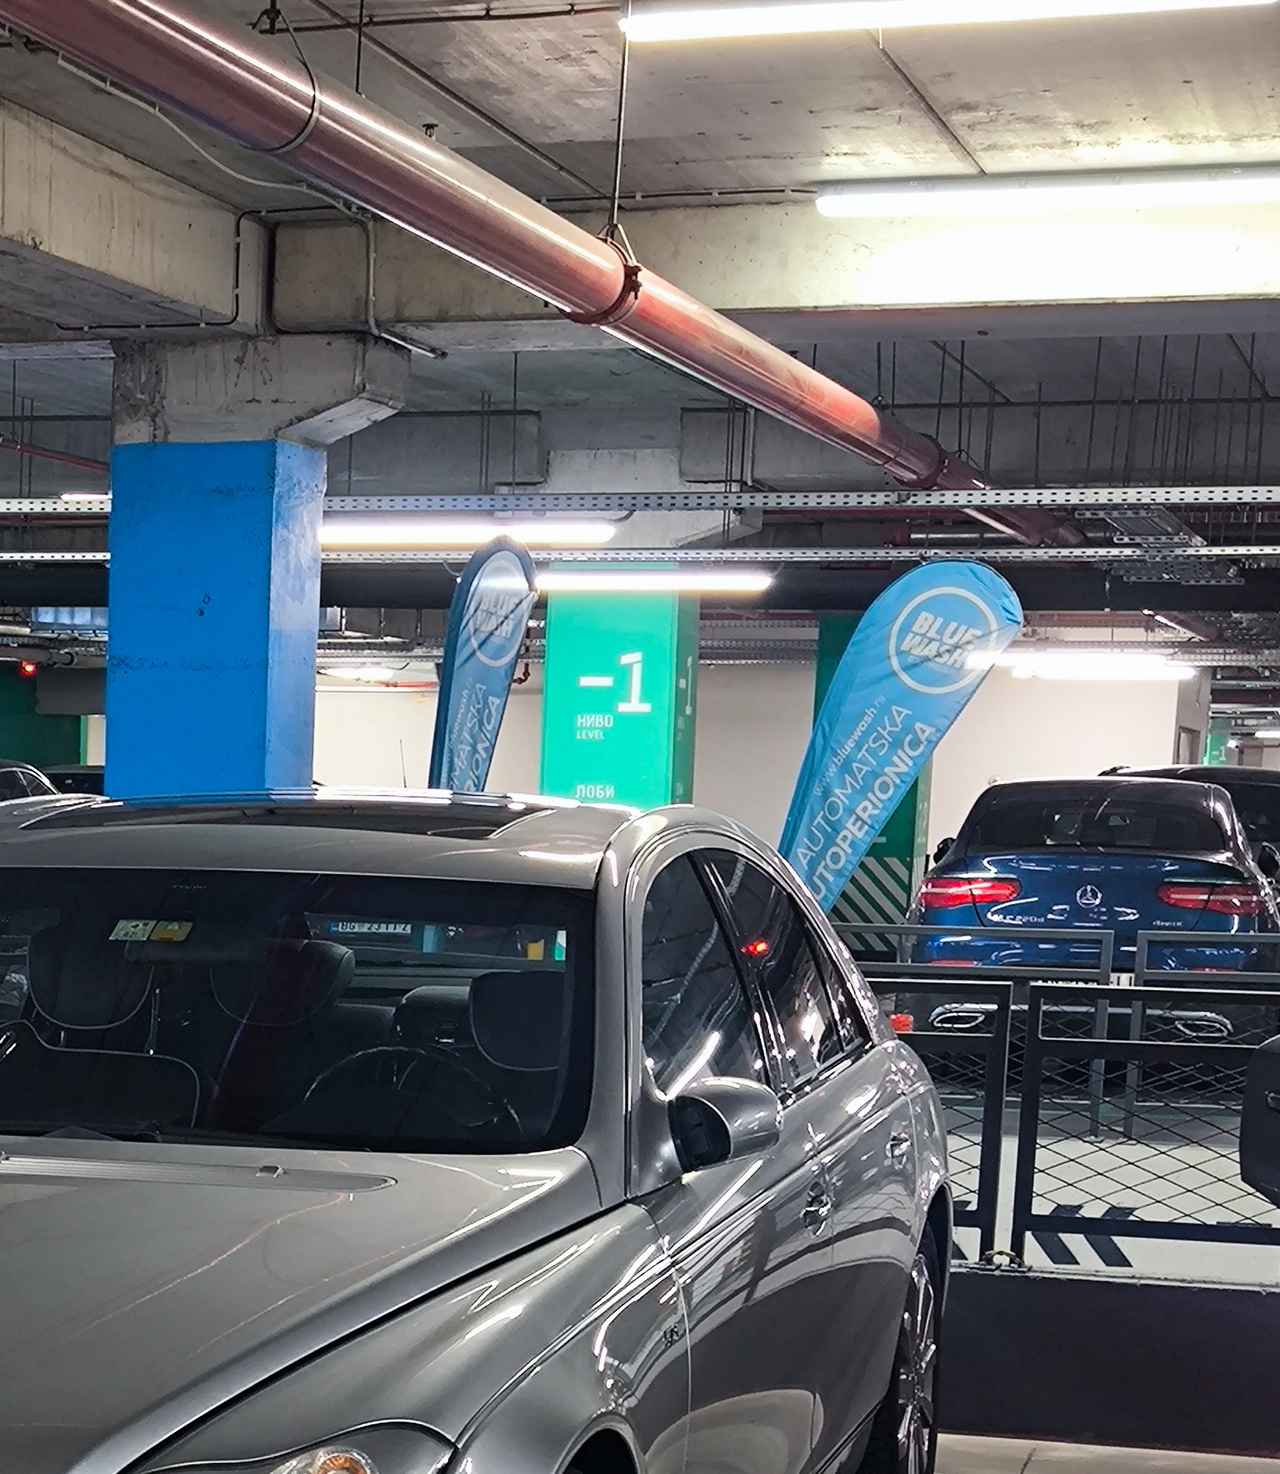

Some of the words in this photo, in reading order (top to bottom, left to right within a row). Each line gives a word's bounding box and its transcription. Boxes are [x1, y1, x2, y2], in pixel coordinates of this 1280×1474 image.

[911, 611, 982, 650] BLUE
[900, 633, 972, 669] WASH
[579, 652, 652, 712] -1
[576, 729, 605, 740] LEVEL
[574, 785, 615, 799] ЛОБИ
[794, 704, 913, 871] AUTOMATSKA
[809, 721, 936, 901] UTOPERIONICA
